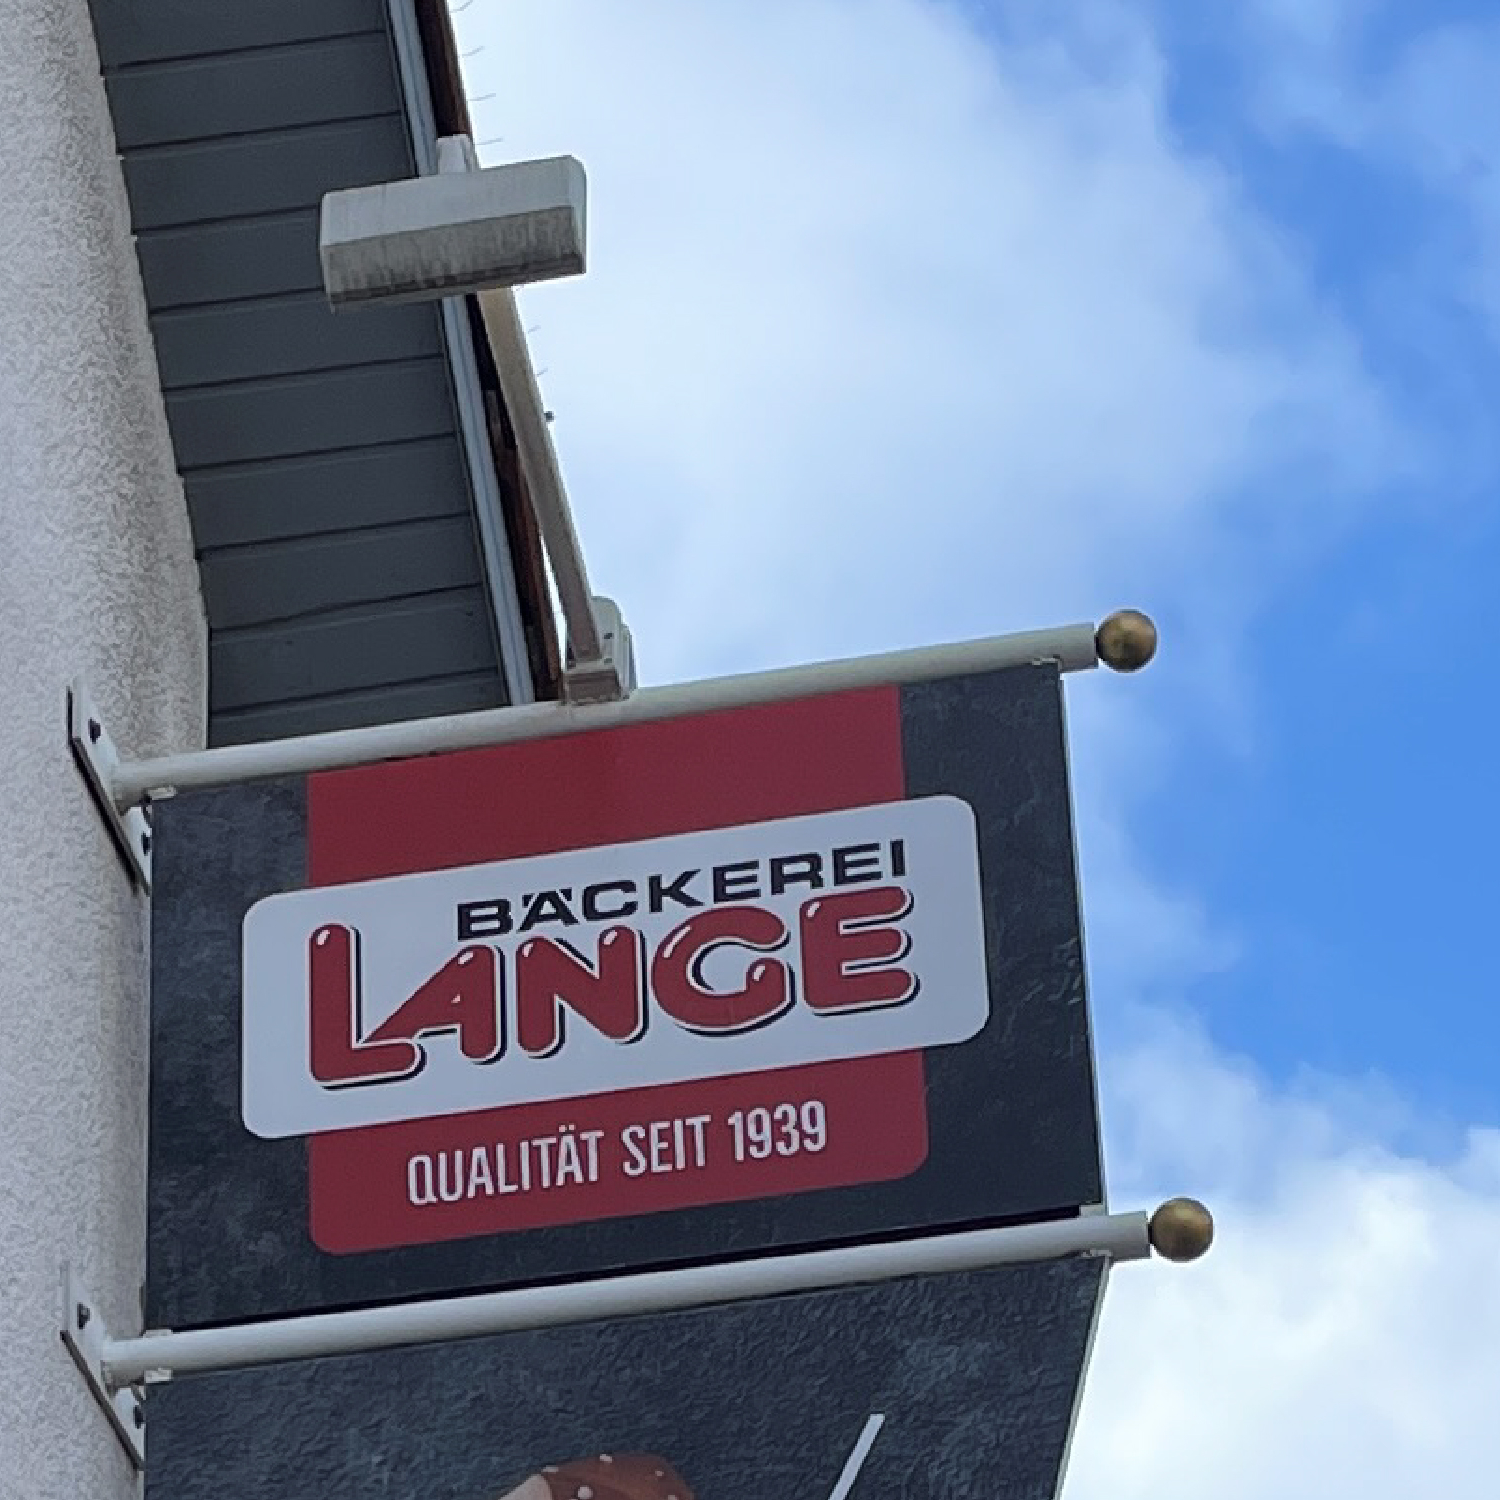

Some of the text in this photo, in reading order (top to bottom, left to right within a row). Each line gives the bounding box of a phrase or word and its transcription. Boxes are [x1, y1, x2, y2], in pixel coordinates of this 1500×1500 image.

[457, 839, 906, 942] BÄCKEREI
[308, 884, 922, 1091] LANGE
[407, 1100, 828, 1207] QUALITÄT SEIT 1939
